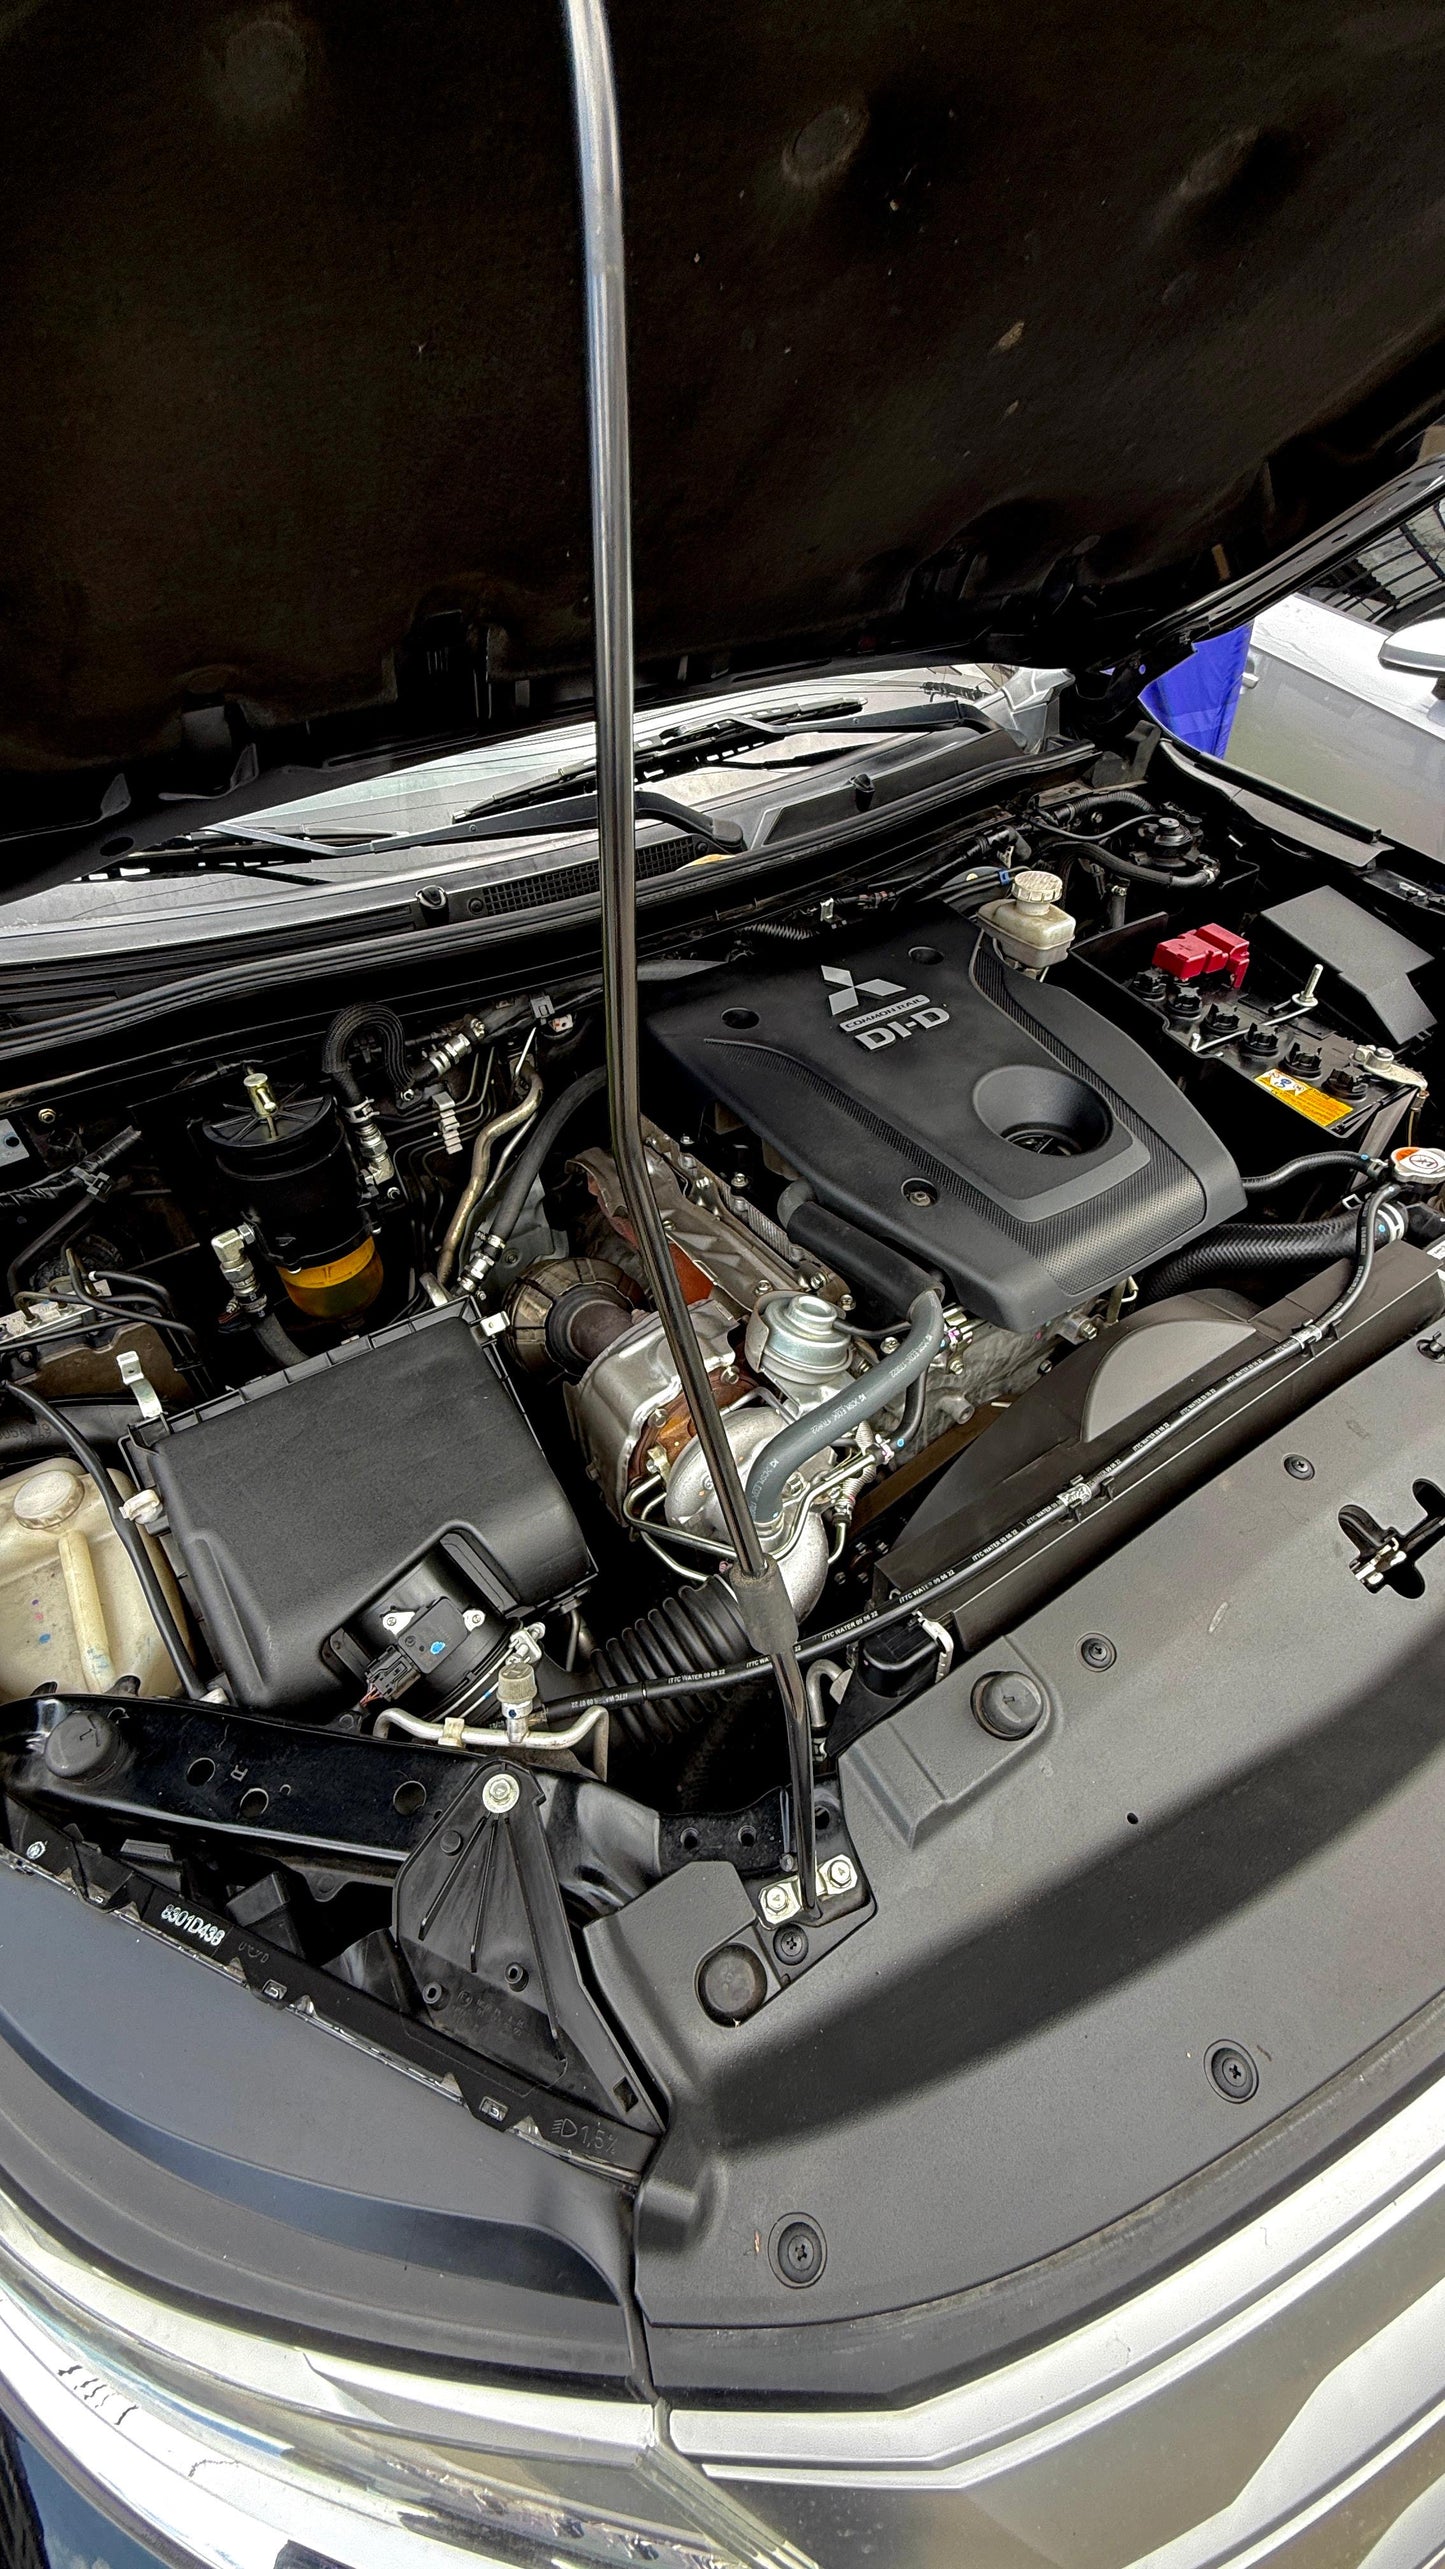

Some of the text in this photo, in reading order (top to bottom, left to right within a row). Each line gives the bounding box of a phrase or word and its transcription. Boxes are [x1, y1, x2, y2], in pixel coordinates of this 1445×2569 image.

[845, 998, 925, 1028] COMMON RAIL
[855, 1007, 950, 1050] DI-D
[983, 1541, 1001, 1553] WATER
[835, 1622, 855, 1634] WATER
[682, 1673, 703, 1682] WATER
[161, 1904, 226, 1946] 8301D438
